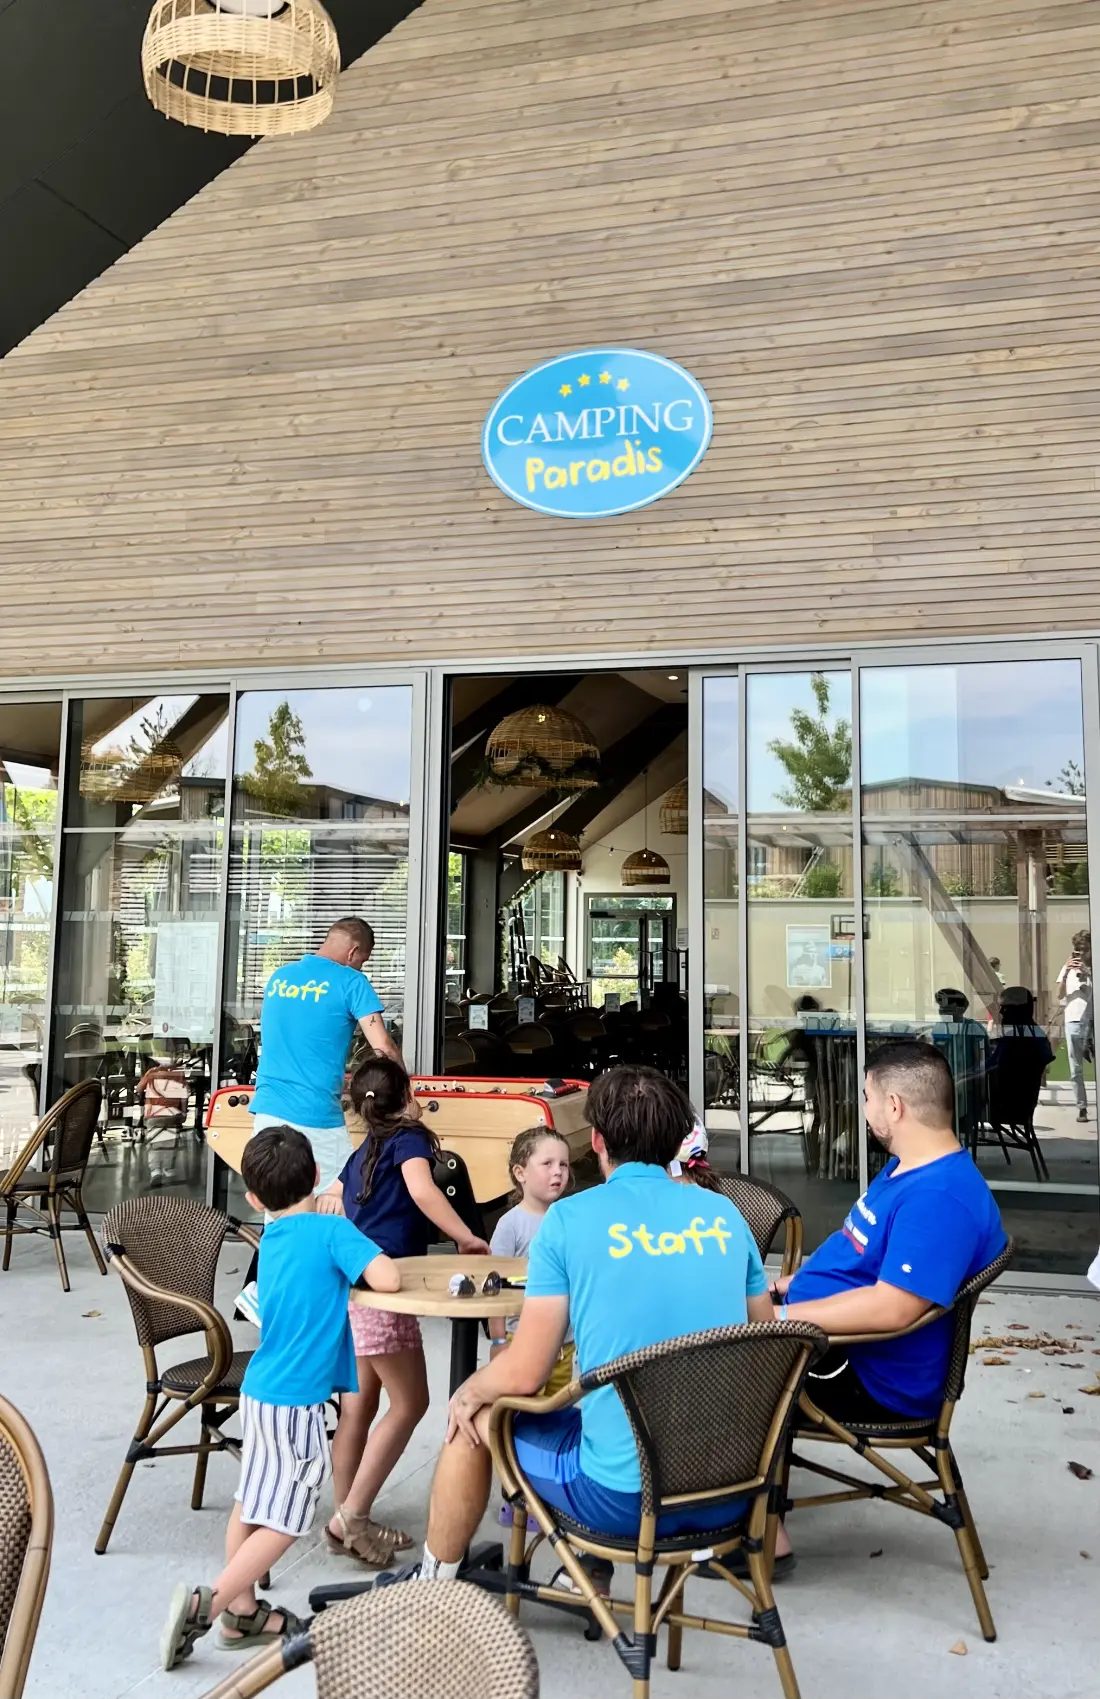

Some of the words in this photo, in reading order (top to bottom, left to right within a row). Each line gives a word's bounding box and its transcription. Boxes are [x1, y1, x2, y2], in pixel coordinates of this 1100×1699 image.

[497, 399, 694, 446] CAMPING
[525, 439, 663, 493] Paradis
[267, 978, 330, 1003] Staff
[607, 1216, 732, 1259] Staff
